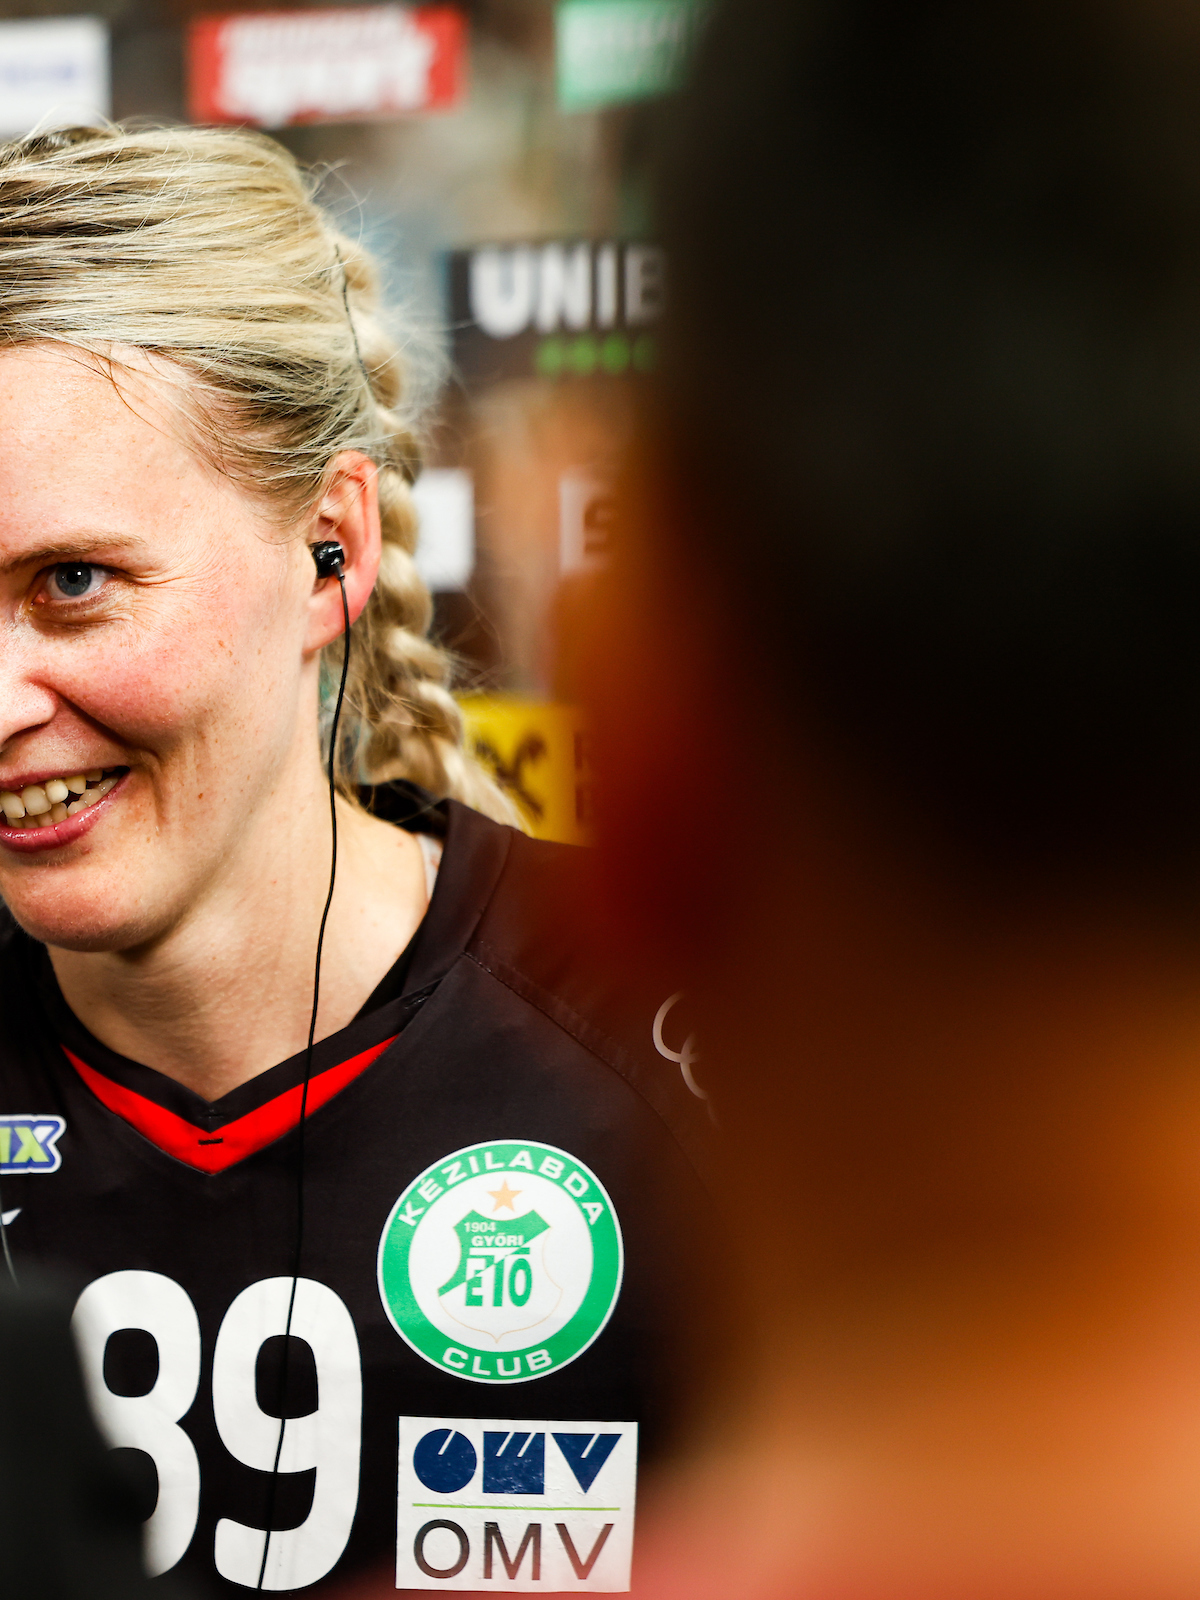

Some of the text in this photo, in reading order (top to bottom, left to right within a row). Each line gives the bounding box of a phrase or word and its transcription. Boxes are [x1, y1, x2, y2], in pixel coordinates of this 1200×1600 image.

[468, 243, 668, 339] UNIB
[398, 1150, 604, 1227] KÉZILABDA
[464, 1222, 496, 1232] 1904
[471, 1232, 524, 1247] GYŐRI
[442, 1347, 553, 1376] CLUB
[69, 1269, 363, 1591] 89
[413, 1518, 615, 1581] OMV
